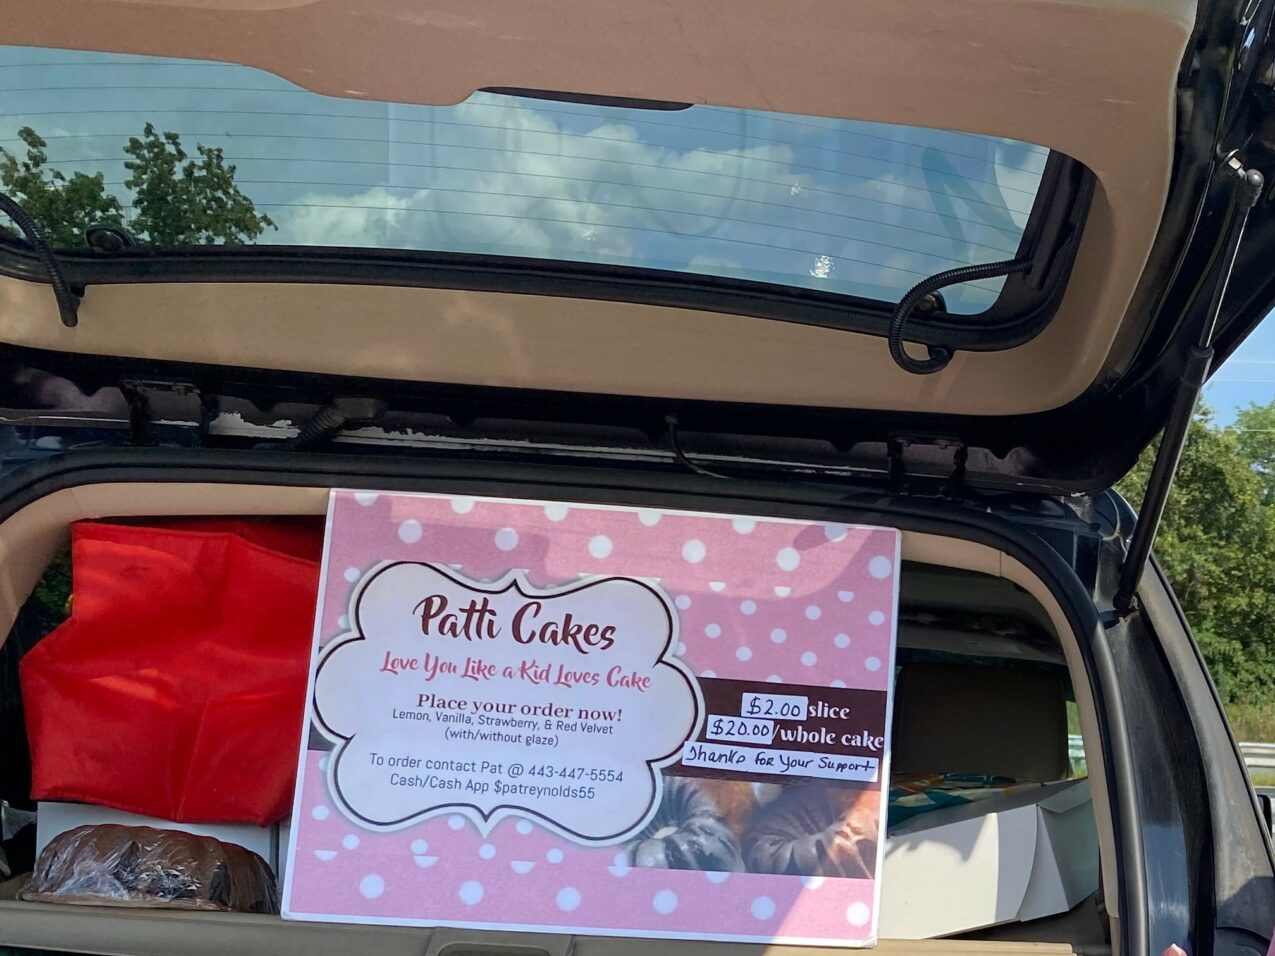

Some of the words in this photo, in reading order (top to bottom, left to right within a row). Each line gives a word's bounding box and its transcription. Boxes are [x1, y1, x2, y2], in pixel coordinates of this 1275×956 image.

[412, 594, 501, 641] Patti
[511, 601, 616, 654] Cakes
[380, 651, 419, 675] Love
[424, 653, 457, 682] You
[461, 657, 497, 682] Like
[502, 665, 516, 679] a
[519, 660, 550, 685] Kid
[554, 664, 599, 688] Loves
[606, 665, 651, 692] Cake
[393, 708, 432, 723] Lemon,
[435, 711, 475, 726] Vanilla,
[478, 715, 540, 731] Strawberry,
[544, 719, 553, 730] &
[556, 720, 577, 732] Red
[580, 722, 614, 735] Velvet
[417, 694, 467, 710] Place
[471, 700, 517, 715] your
[521, 702, 573, 718] order
[578, 708, 622, 722] now!
[746, 696, 801, 717] $2.00
[809, 701, 850, 720] slice
[445, 726, 522, 744] (with/without
[525, 731, 559, 747] glaze)
[711, 719, 770, 737] $20.00
[841, 731, 884, 751] cake
[370, 753, 384, 766] To
[388, 755, 422, 769] order
[426, 759, 476, 773] contact
[481, 761, 503, 774] Pat
[507, 763, 524, 778] @
[528, 765, 623, 783] 443-447-5554
[685, 742, 746, 763] Thanks
[780, 754, 814, 773] Your
[819, 756, 875, 772] Support
[390, 773, 462, 790] Cash/Cash
[465, 777, 489, 794] App
[494, 779, 595, 800] $patreynolds55
